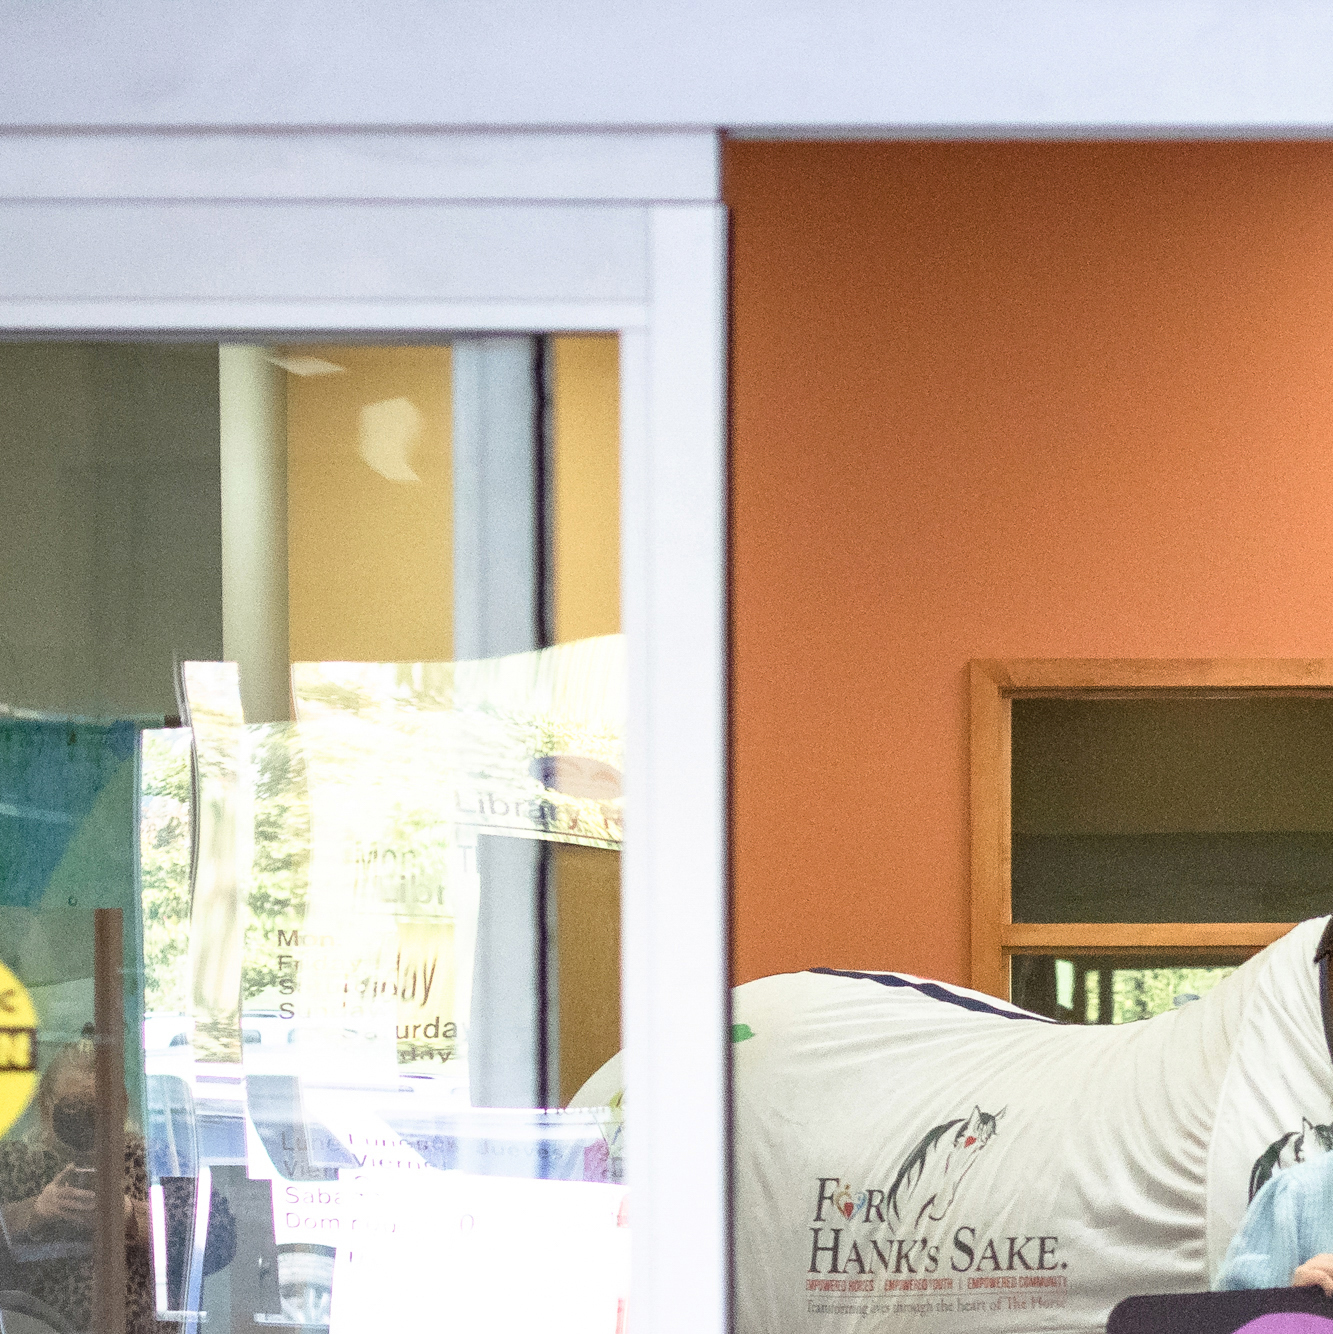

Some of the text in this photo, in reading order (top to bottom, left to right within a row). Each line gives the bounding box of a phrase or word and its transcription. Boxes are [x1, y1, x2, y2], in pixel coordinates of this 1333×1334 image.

[967, 1276, 1017, 1289] EMPOWERED
[936, 1299, 953, 1313] the
[957, 1297, 986, 1311] heart
